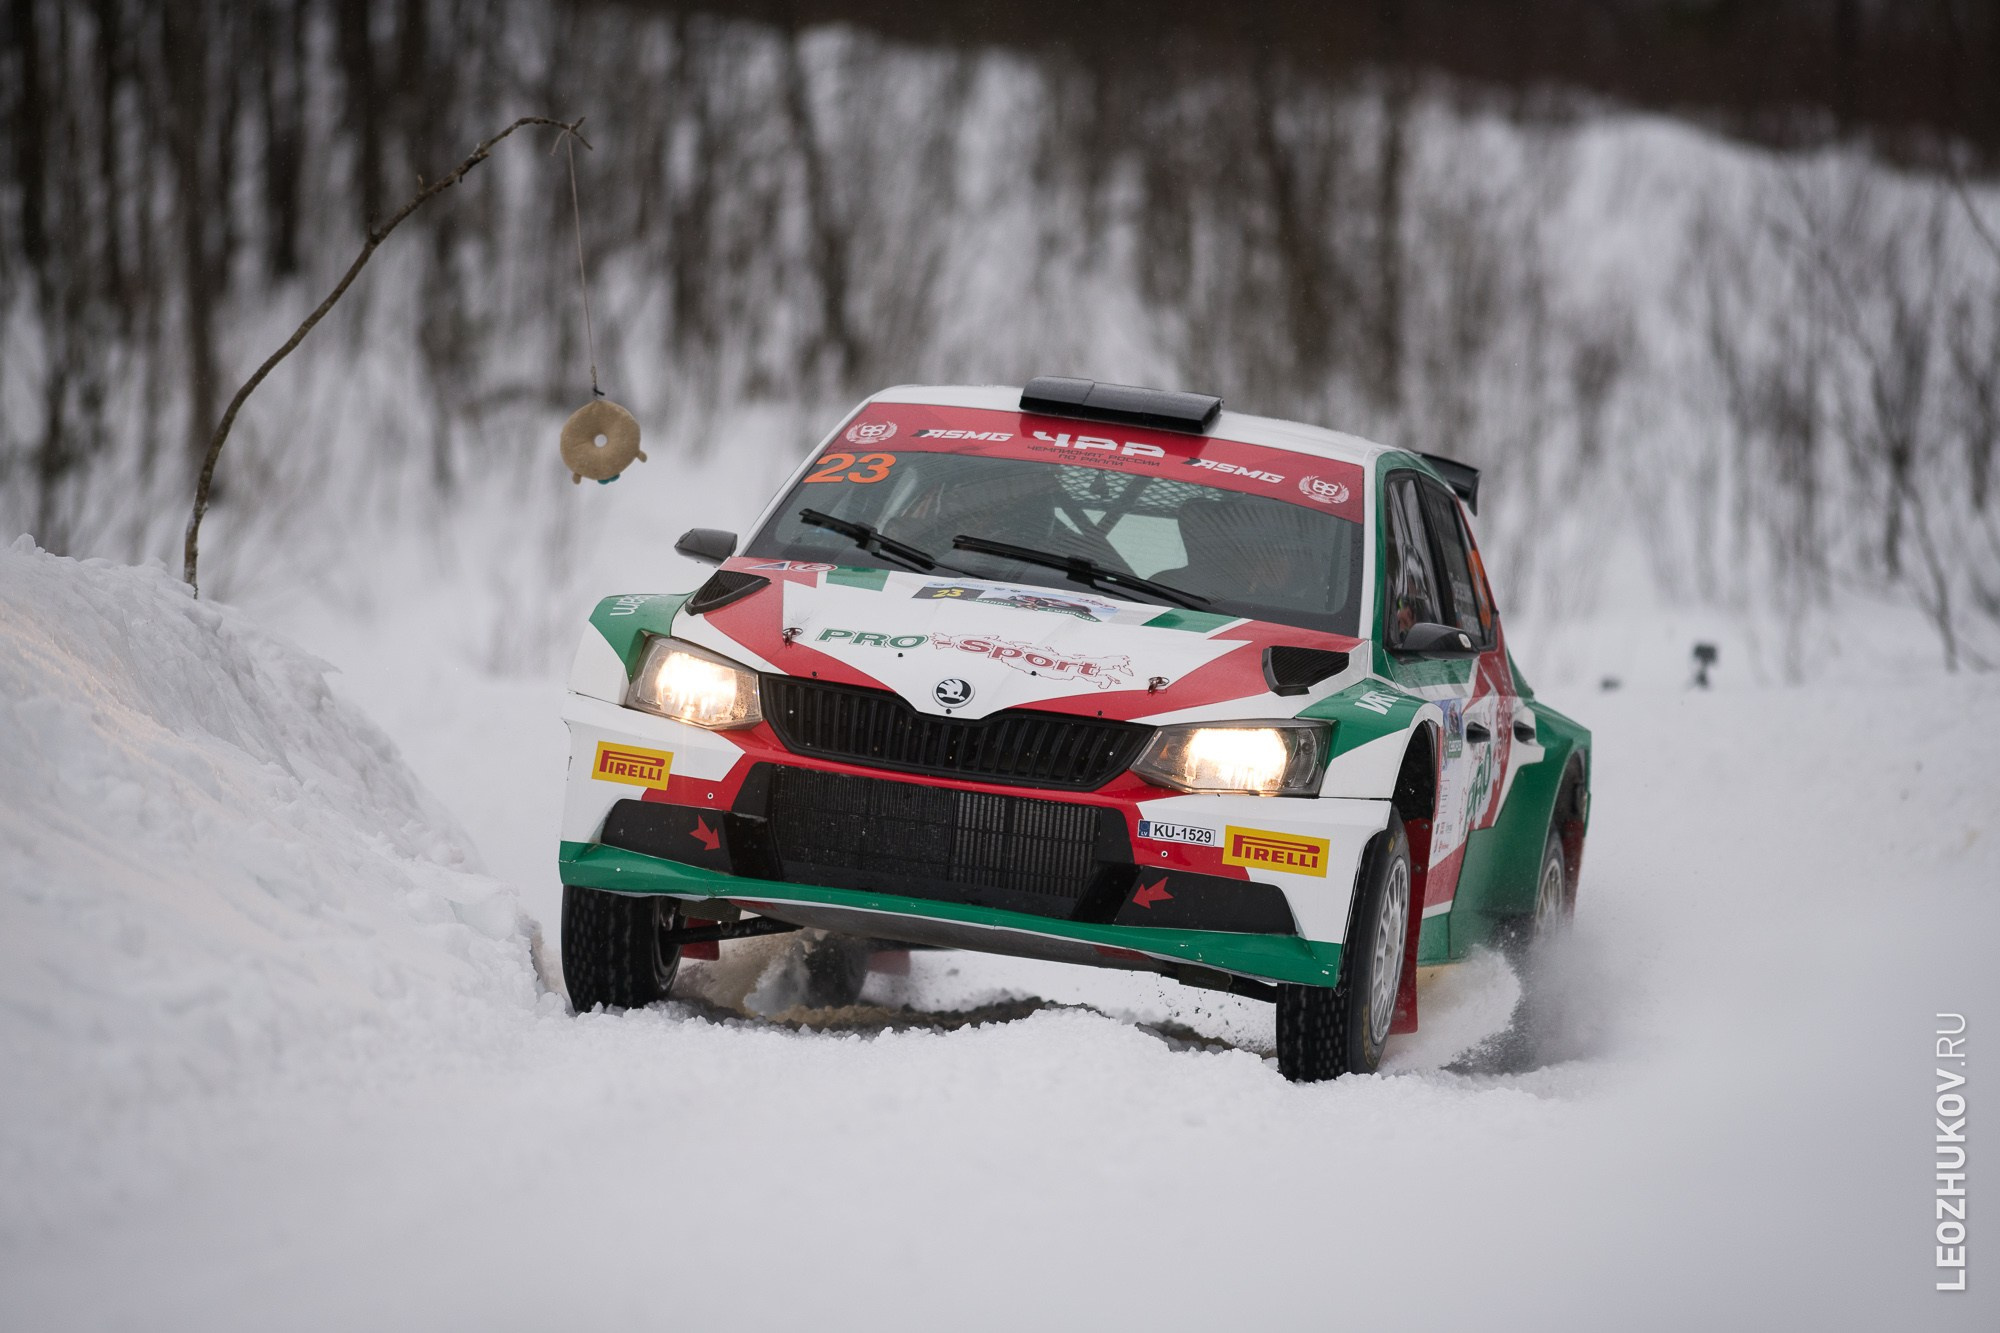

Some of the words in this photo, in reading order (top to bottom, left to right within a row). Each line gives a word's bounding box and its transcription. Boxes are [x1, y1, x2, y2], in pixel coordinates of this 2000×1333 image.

[1027, 445, 1104, 458] ЧЕМПИОНАТ
[1108, 455, 1160, 467] РОССИИ
[1080, 457, 1124, 467] РАЛЛИ
[804, 453, 897, 483] 23
[932, 588, 964, 598] 23
[599, 750, 666, 781] PIRELLI
[1154, 824, 1212, 843] KU-1529
[1232, 834, 1321, 869] PIRELLI
